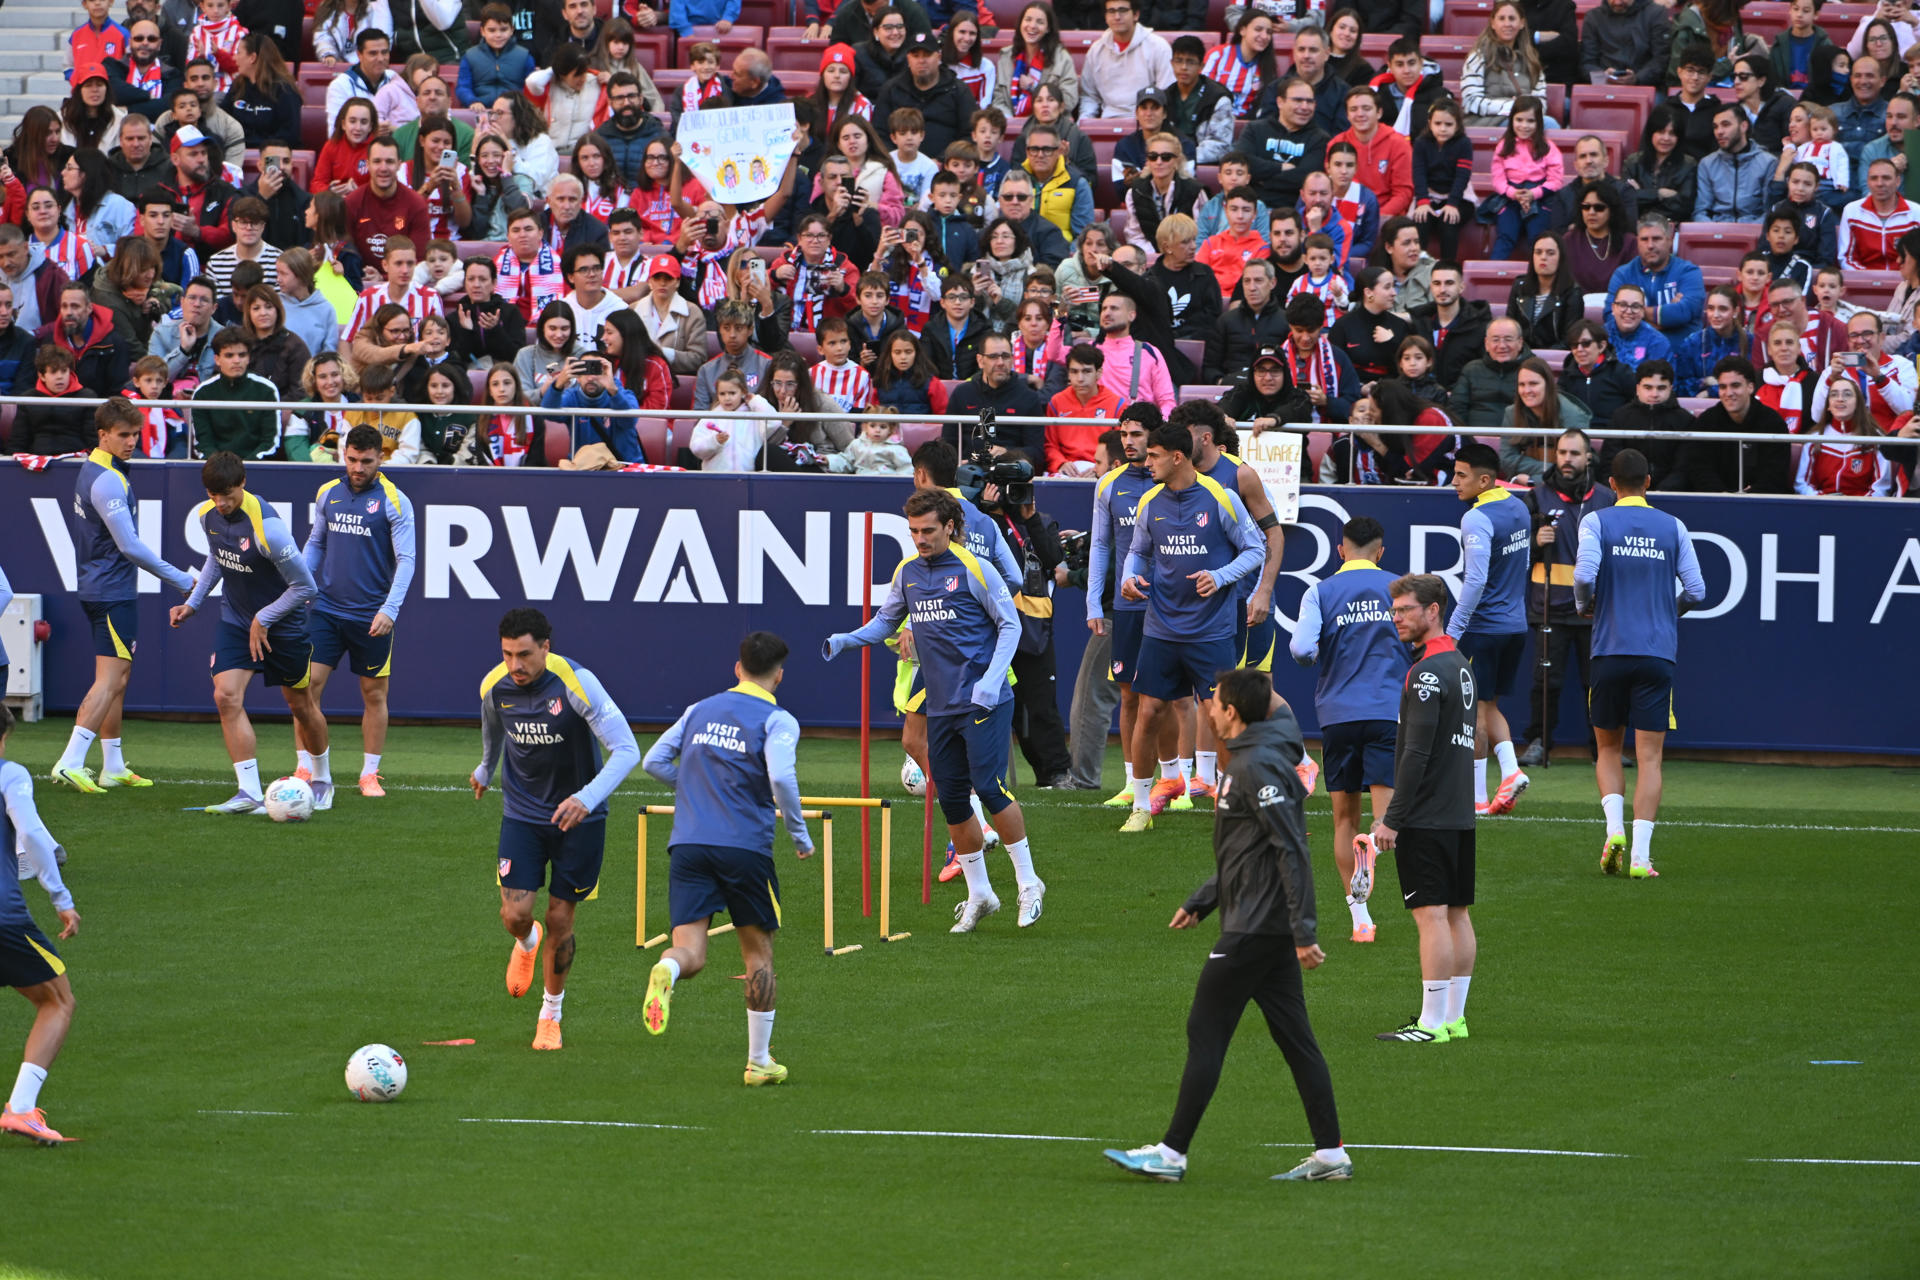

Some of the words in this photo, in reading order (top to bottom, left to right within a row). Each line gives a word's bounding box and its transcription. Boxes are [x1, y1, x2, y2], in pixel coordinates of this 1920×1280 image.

[335, 513, 364, 525] VISIT
[1167, 535, 1196, 545] VISIT
[1510, 529, 1527, 542] VISIT
[1624, 536, 1656, 548] VISIT
[218, 548, 241, 564] VISIT
[424, 504, 911, 607] RWAND
[1160, 545, 1208, 555] RWANDA
[1612, 546, 1665, 561] RWANDA
[915, 599, 944, 612] VISIT
[1347, 600, 1380, 613] VISIT
[1336, 610, 1393, 627] RWANDA
[1412, 683, 1441, 693] HYUNDAI
[515, 722, 548, 734] VISIT
[707, 722, 740, 737] VISIT
[692, 734, 746, 753] RWANDA
